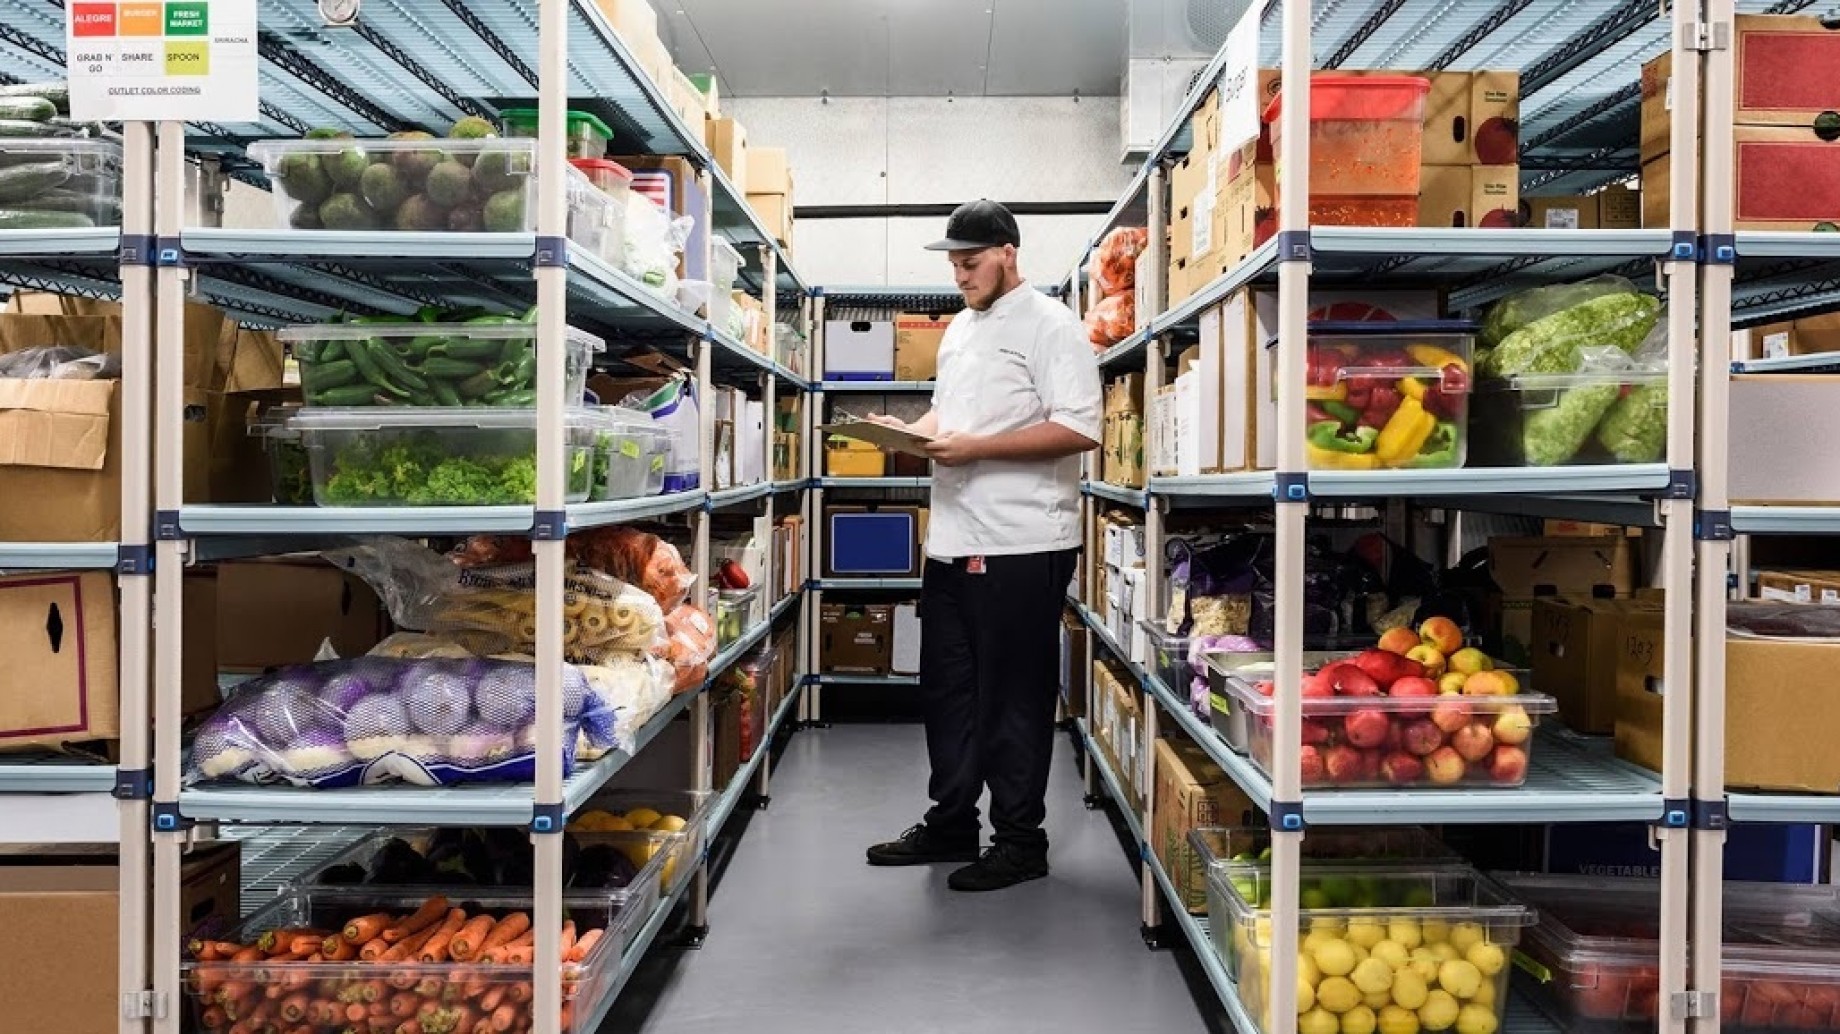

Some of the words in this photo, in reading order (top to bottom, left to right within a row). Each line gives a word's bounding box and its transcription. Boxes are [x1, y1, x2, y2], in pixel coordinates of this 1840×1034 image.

[74, 13, 112, 23] ALEGRE
[173, 10, 200, 18] FRESH
[169, 19, 203, 27] MARKET
[76, 53, 103, 62] GRAB
[121, 53, 154, 62] SHARE
[166, 53, 200, 62] SPOON
[88, 64, 103, 73] GO
[108, 87, 139, 95] OUTLET
[141, 87, 169, 95] COLOR
[169, 86, 201, 95] CODING
